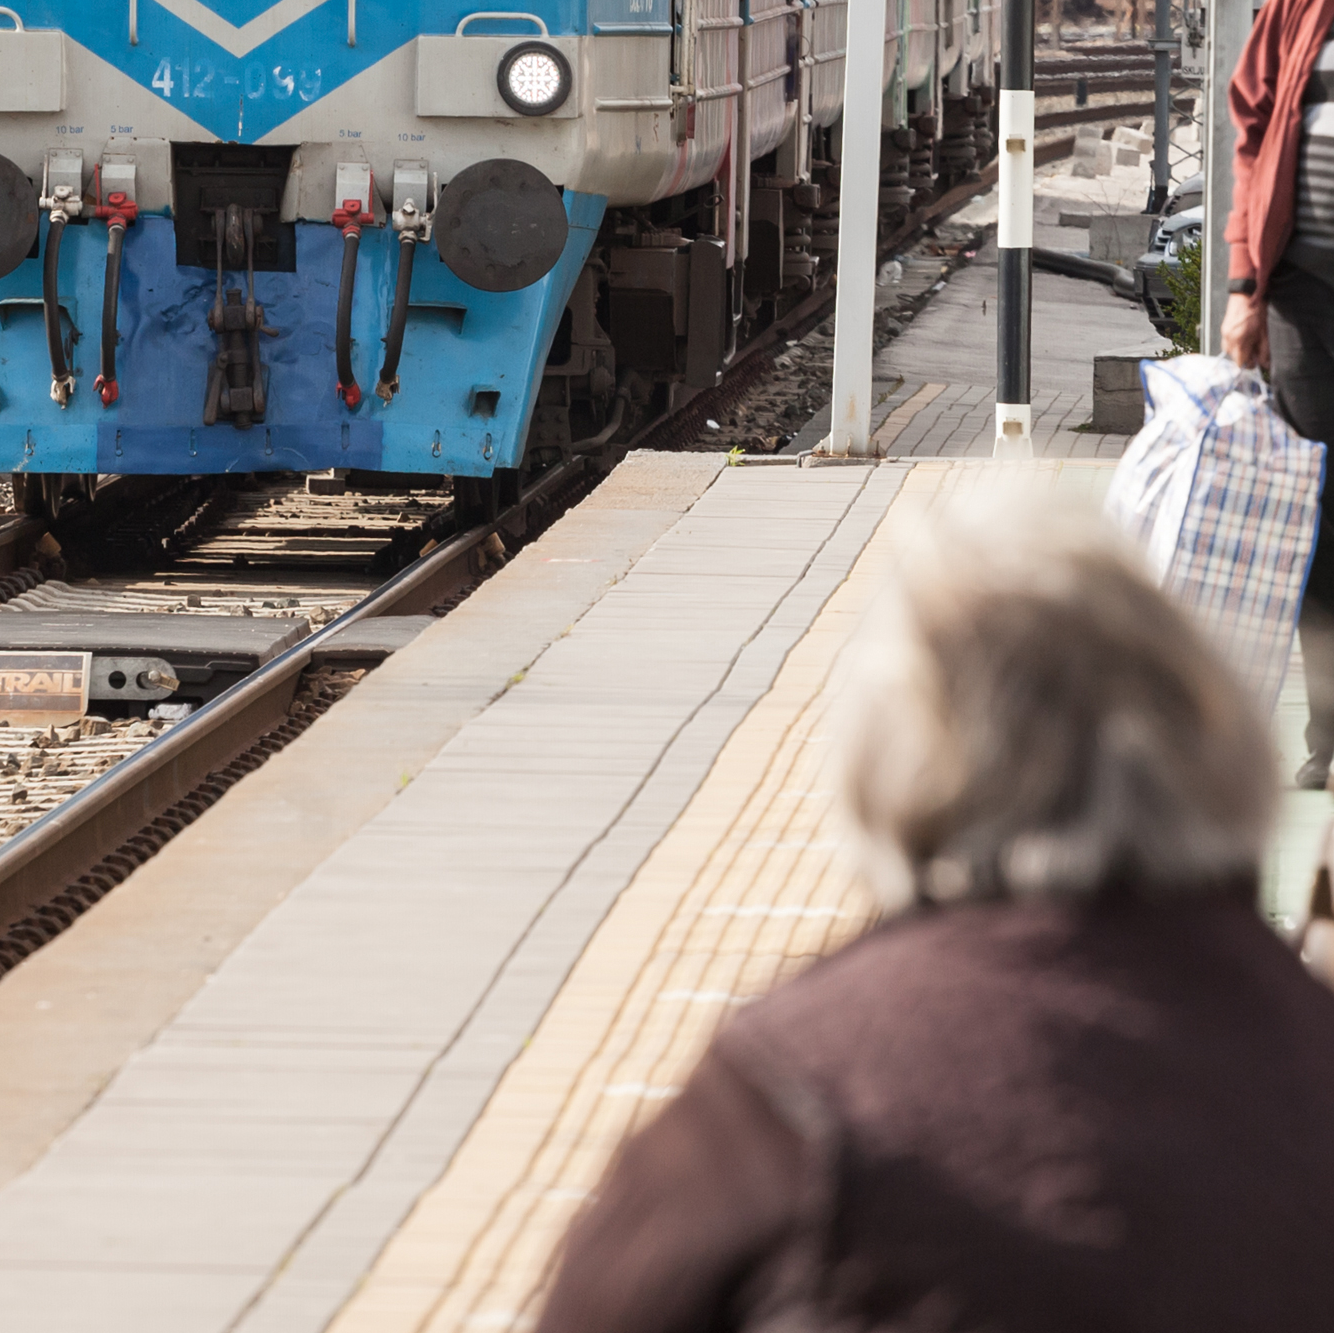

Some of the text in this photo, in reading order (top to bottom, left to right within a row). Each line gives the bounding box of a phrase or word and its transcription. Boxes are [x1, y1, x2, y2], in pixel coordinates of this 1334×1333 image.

[56, 125, 84, 134] 10 bar
[110, 125, 133, 133] 5 bar
[339, 129, 362, 138] 5 bar
[398, 133, 426, 141] 10 bar
